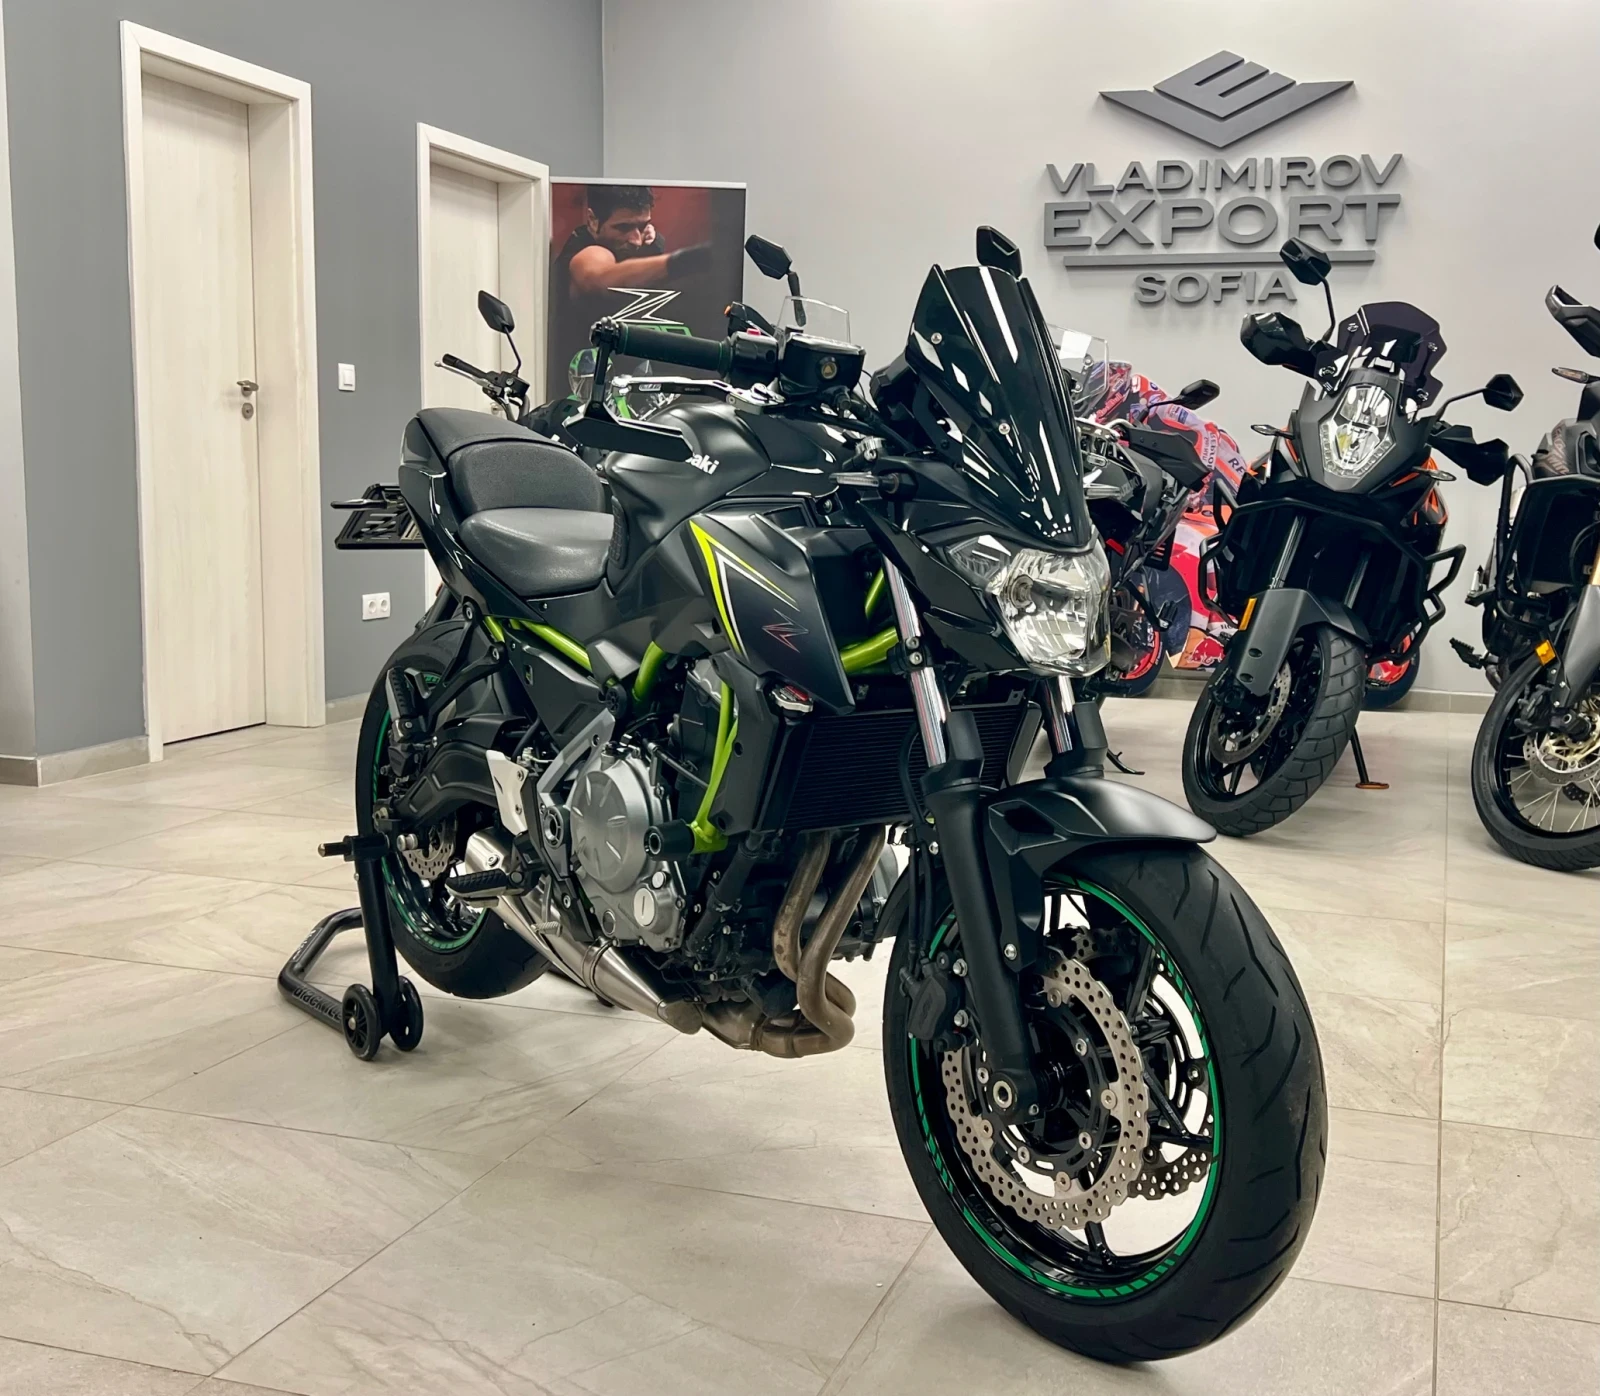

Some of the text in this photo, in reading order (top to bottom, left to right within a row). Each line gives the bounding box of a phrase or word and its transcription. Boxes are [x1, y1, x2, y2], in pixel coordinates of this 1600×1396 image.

[1046, 153, 1403, 194] VLADIMIROV
[1044, 194, 1402, 247] EXPORT
[1134, 270, 1297, 303] SOFIA
[685, 454, 720, 475] aki
